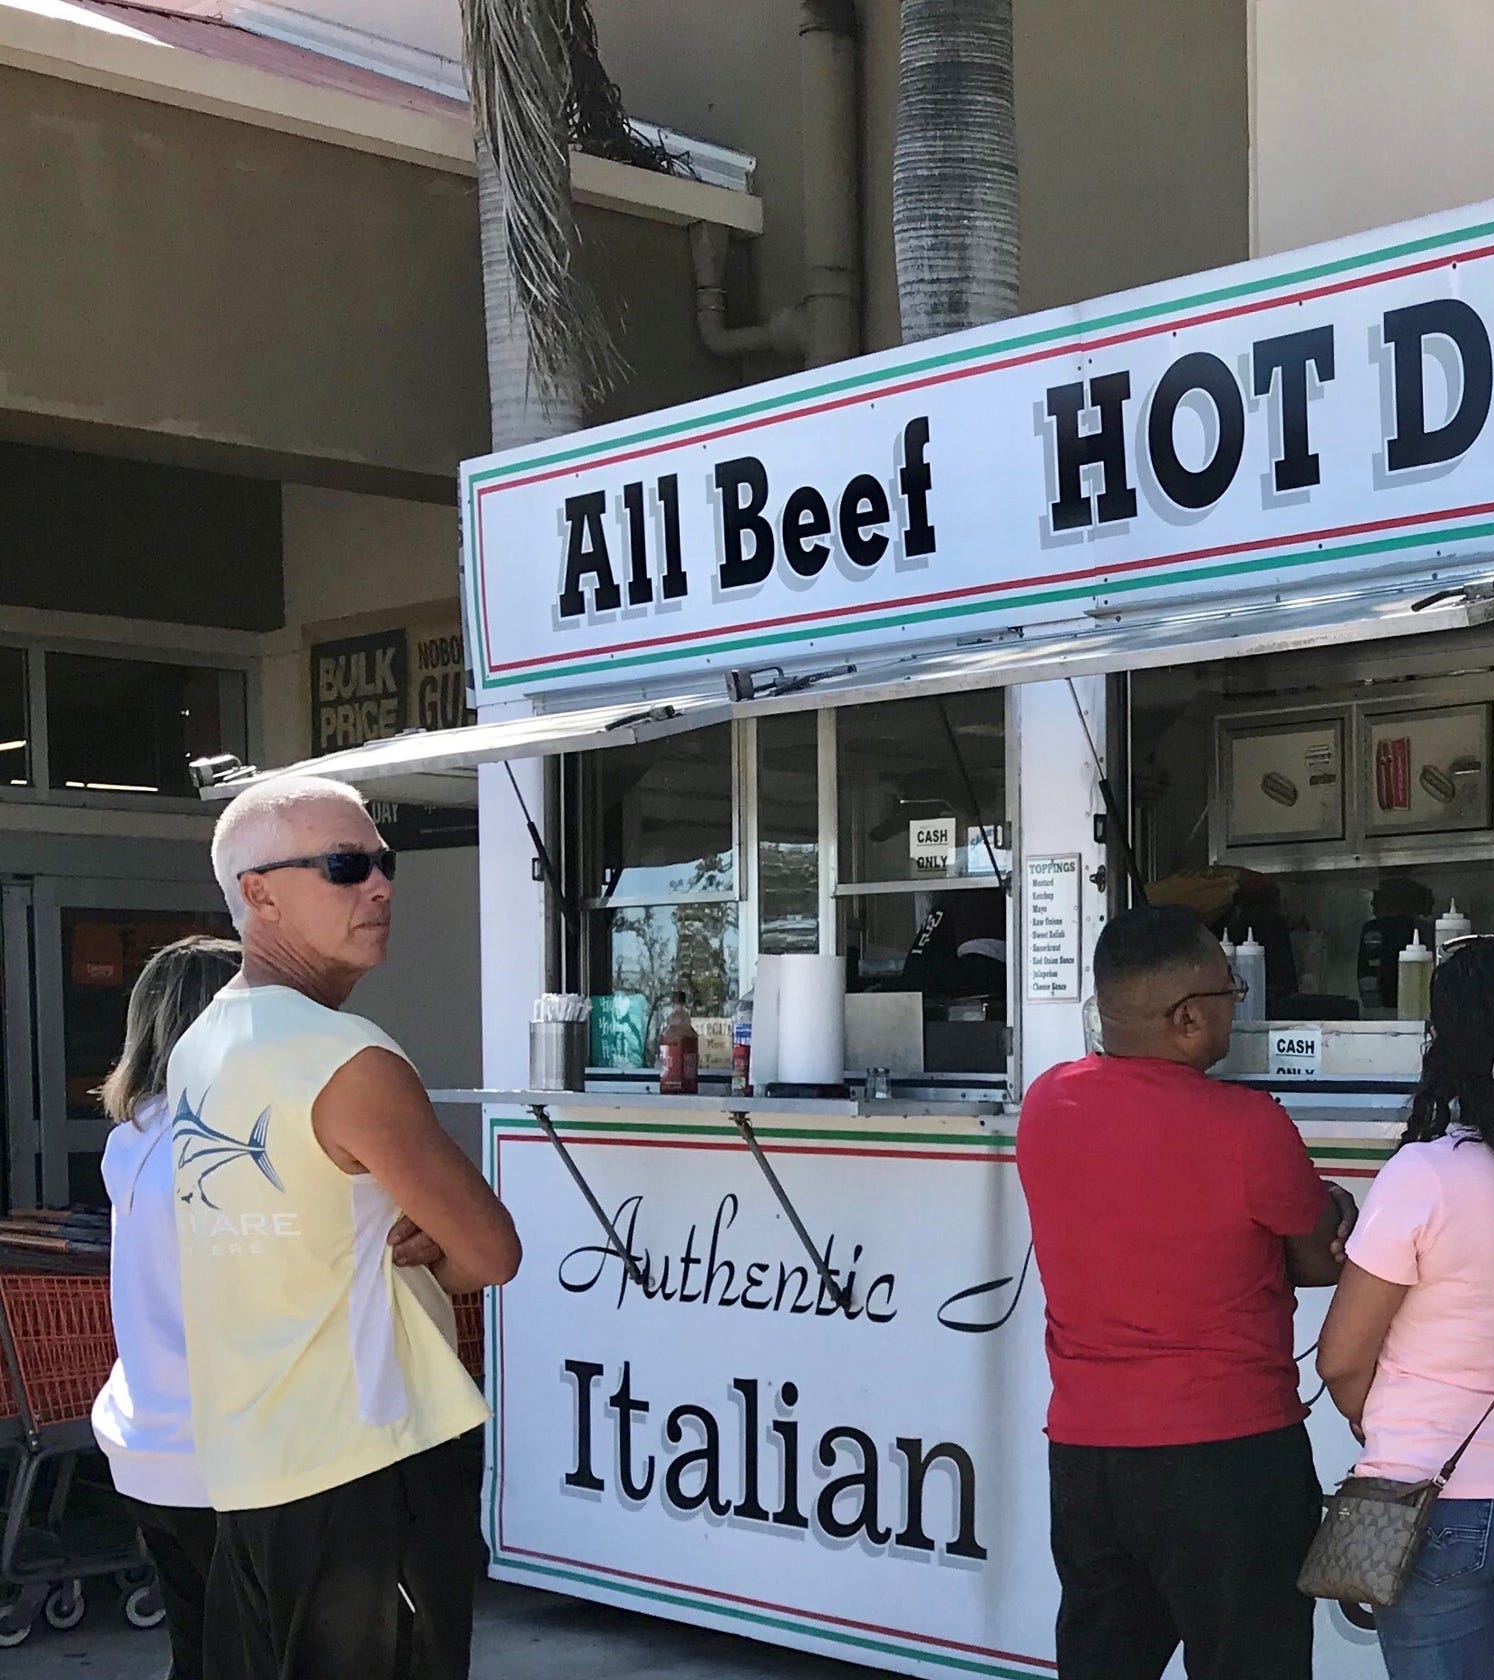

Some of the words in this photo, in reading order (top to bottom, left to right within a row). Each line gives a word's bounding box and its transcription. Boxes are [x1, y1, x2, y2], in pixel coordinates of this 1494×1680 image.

[559, 473, 688, 617] All
[714, 416, 936, 590] Beef
[1045, 324, 1335, 531] HOT
[318, 646, 398, 703] BULK
[320, 697, 399, 749] PRICE
[917, 829, 949, 843] CASH
[916, 855, 949, 870] ONLY
[1029, 862, 1076, 875] TOPPINGS
[1276, 1038, 1315, 1054] CASH
[558, 1193, 898, 1324] Authentic
[564, 1359, 988, 1561] Italian
